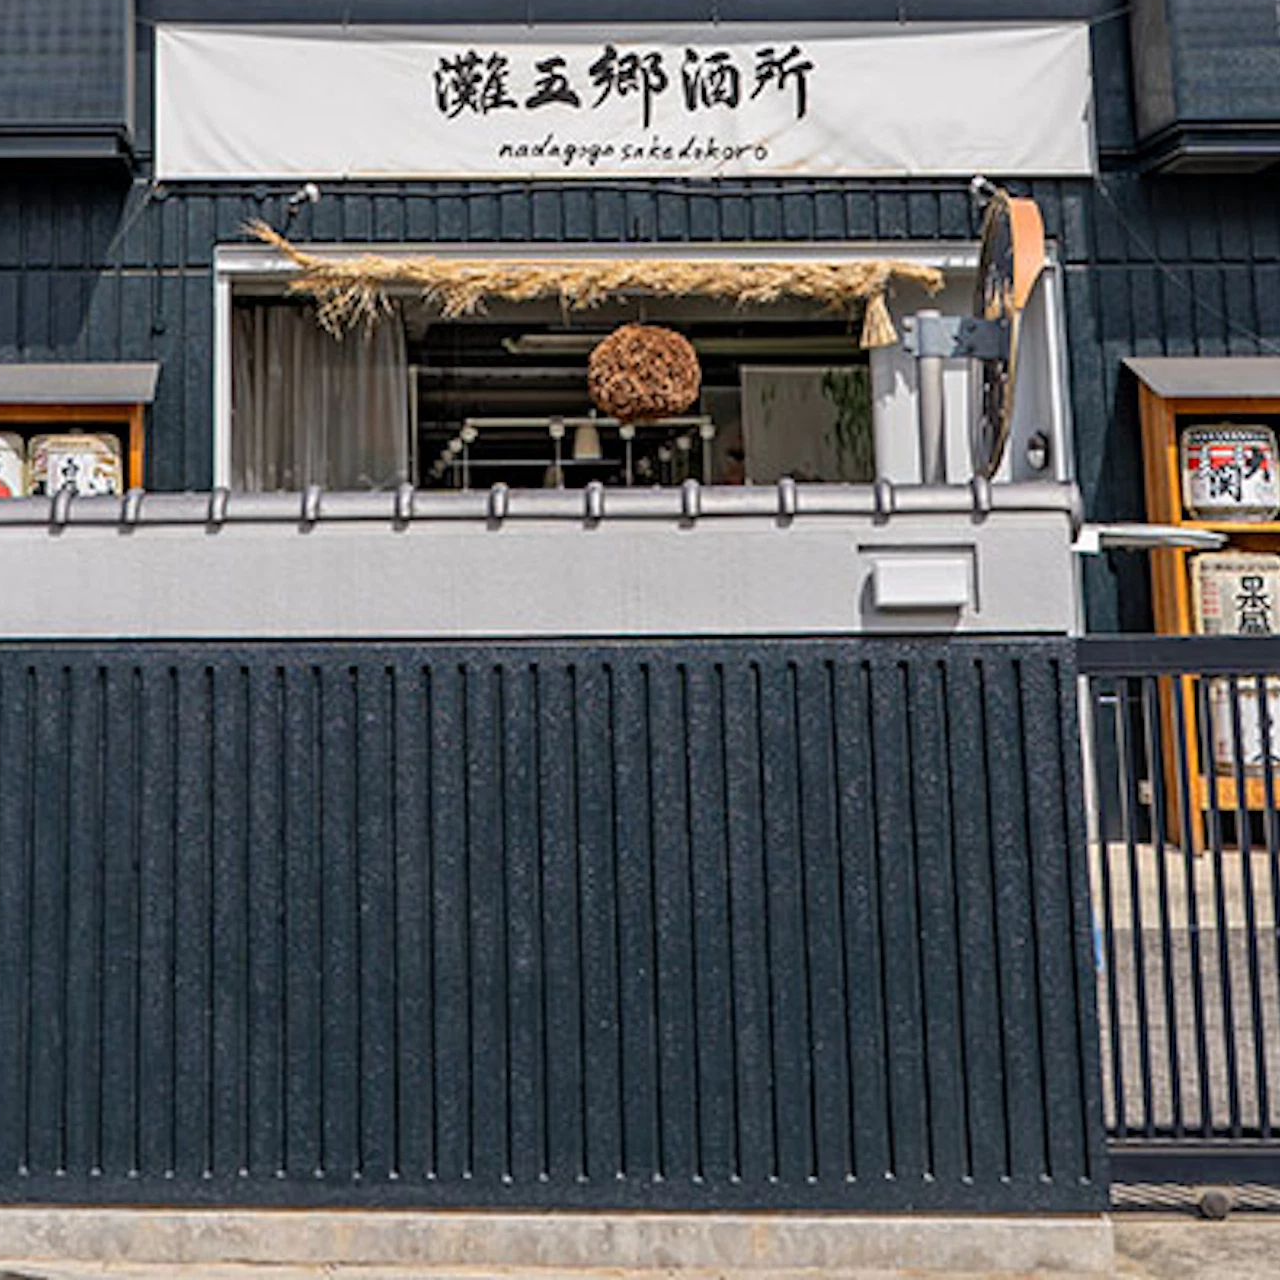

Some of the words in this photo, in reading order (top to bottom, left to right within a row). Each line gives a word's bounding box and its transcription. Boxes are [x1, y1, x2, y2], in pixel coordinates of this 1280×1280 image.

[433, 44, 813, 128] 灘五郷酒所
